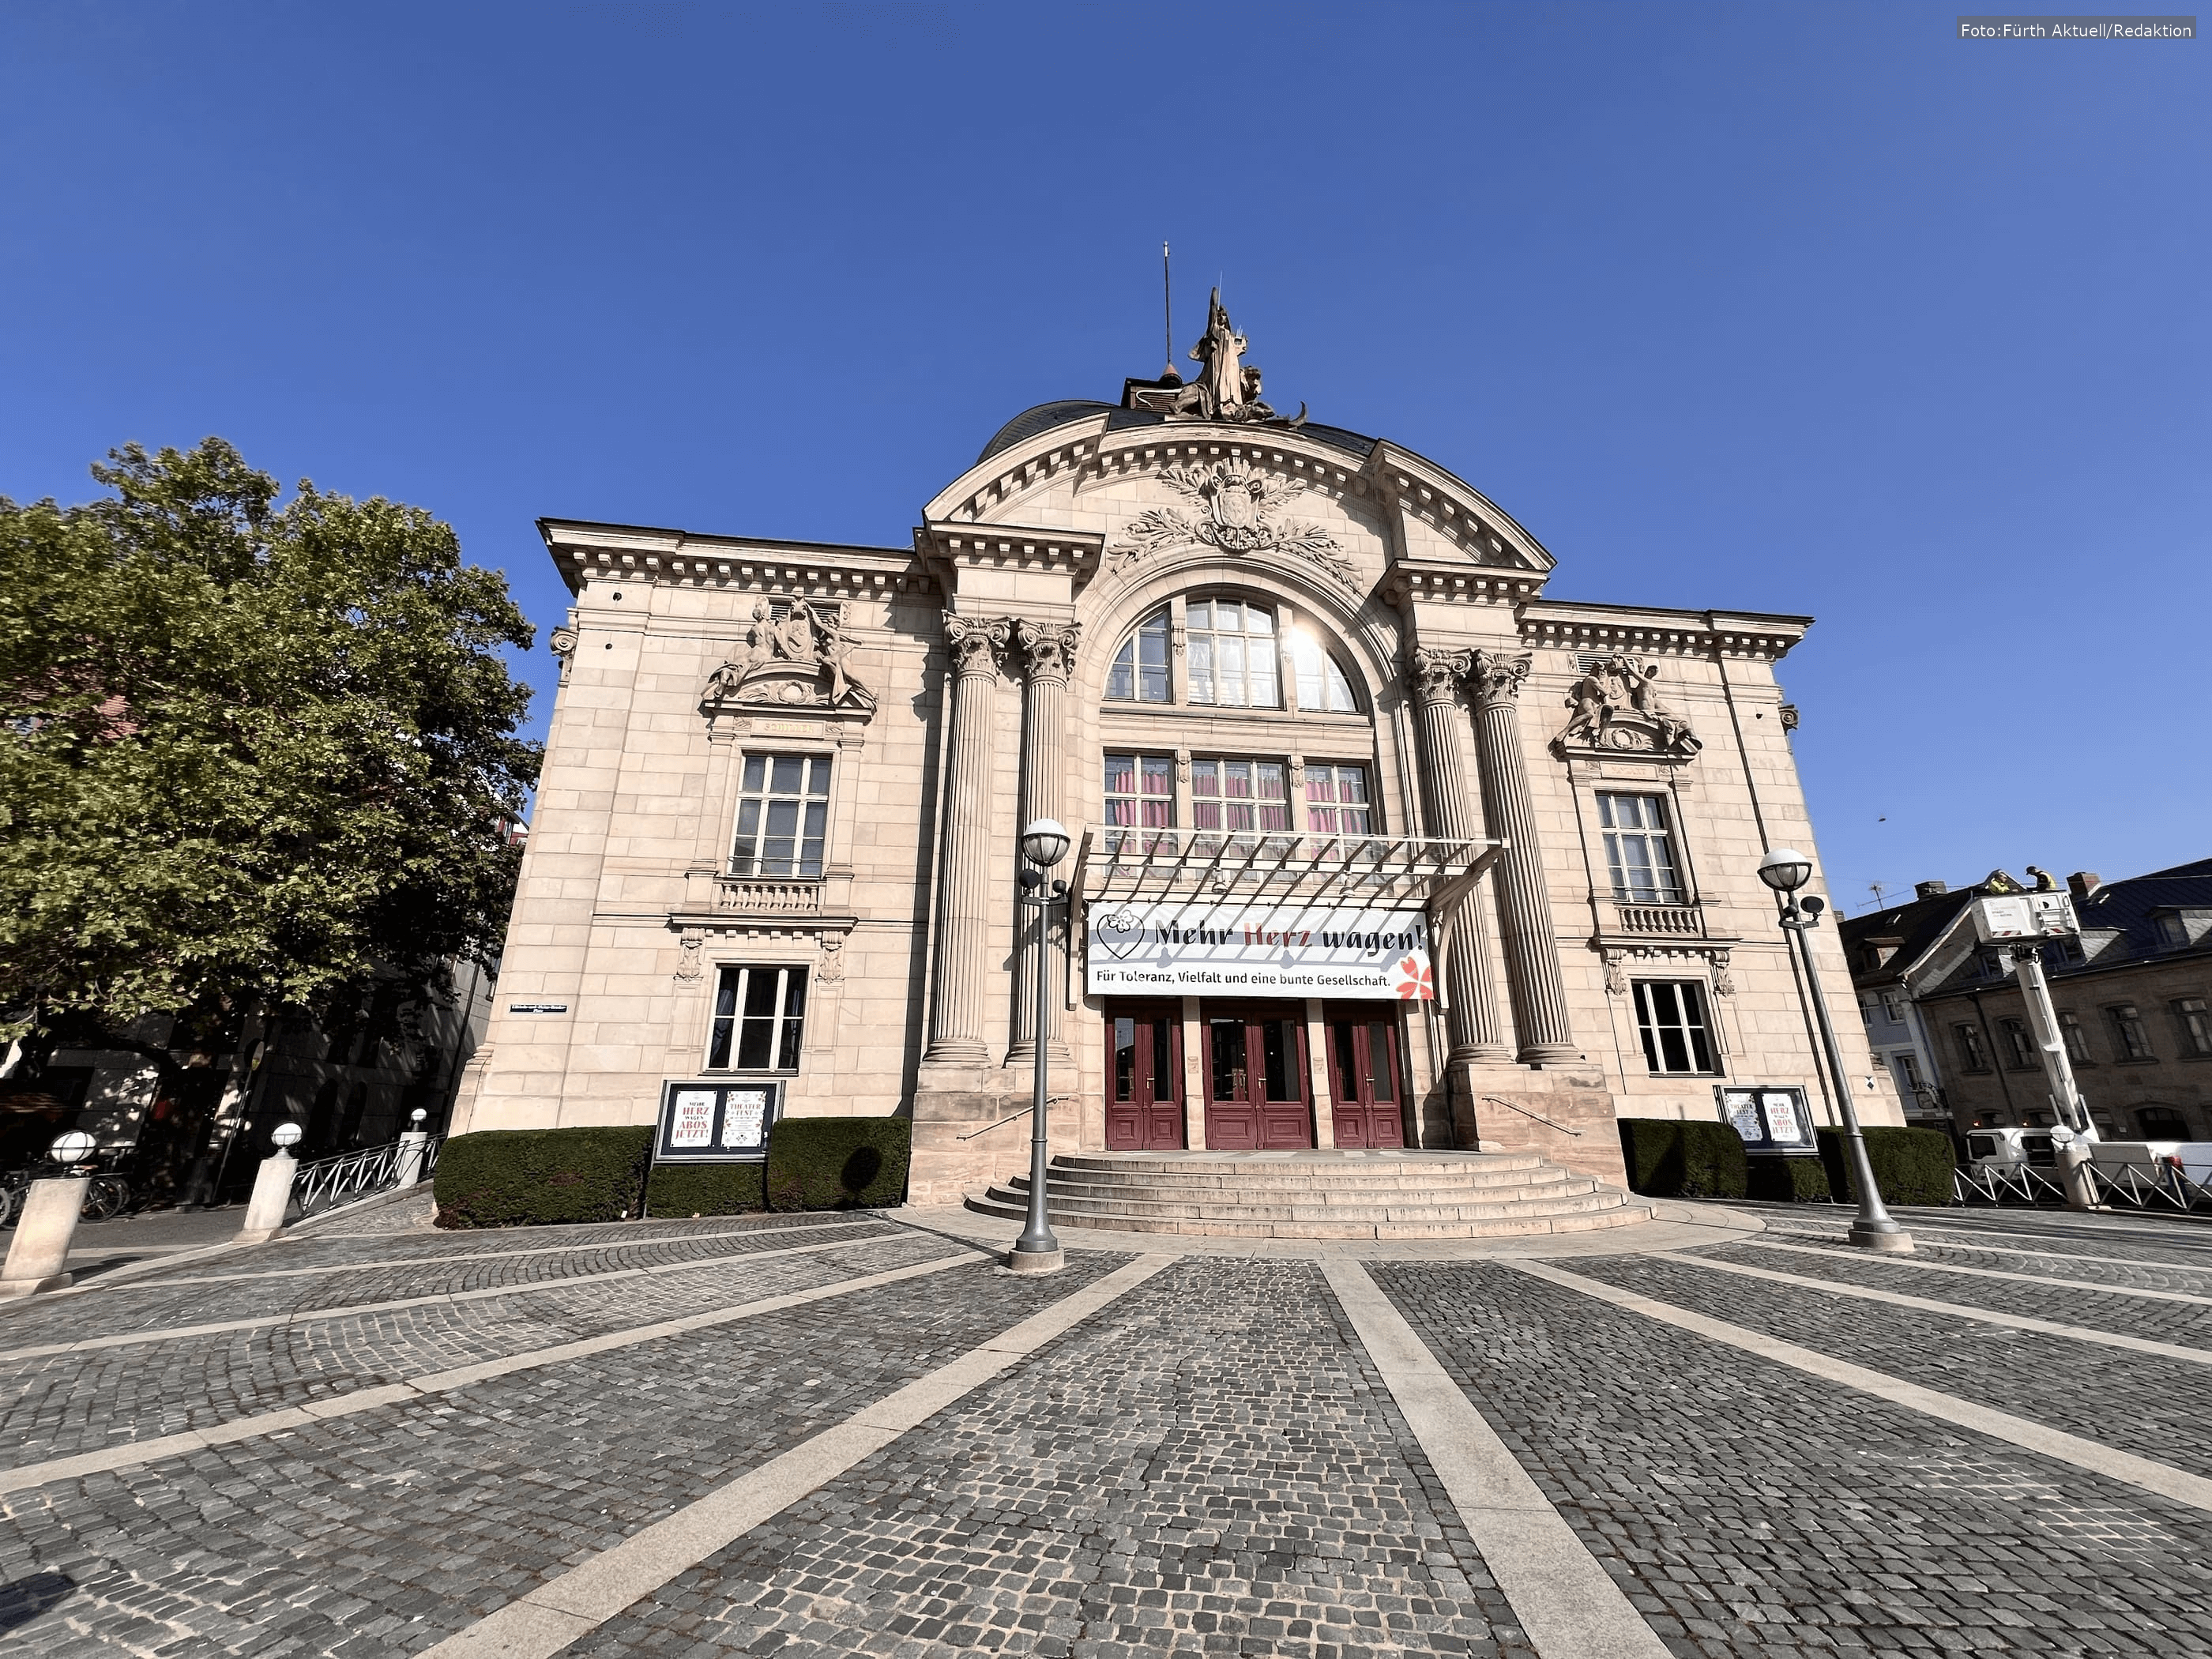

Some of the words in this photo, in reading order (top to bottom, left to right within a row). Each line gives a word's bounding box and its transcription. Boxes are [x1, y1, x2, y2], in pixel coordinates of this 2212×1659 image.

[1155, 920, 1233, 946] Mehr
[1243, 922, 1313, 947] Herz
[1322, 924, 1424, 957] wagen!
[1097, 970, 1116, 982] Für
[1119, 971, 1176, 984] Toleranz,
[1178, 971, 1221, 984] Vielfalt
[1224, 972, 1247, 984] und
[1251, 972, 1277, 985] eine
[1280, 973, 1314, 985] bunte
[1317, 974, 1391, 987] Gesellschaft.
[683, 1107, 709, 1115] HERZ
[675, 1129, 709, 1139] JETZT!
